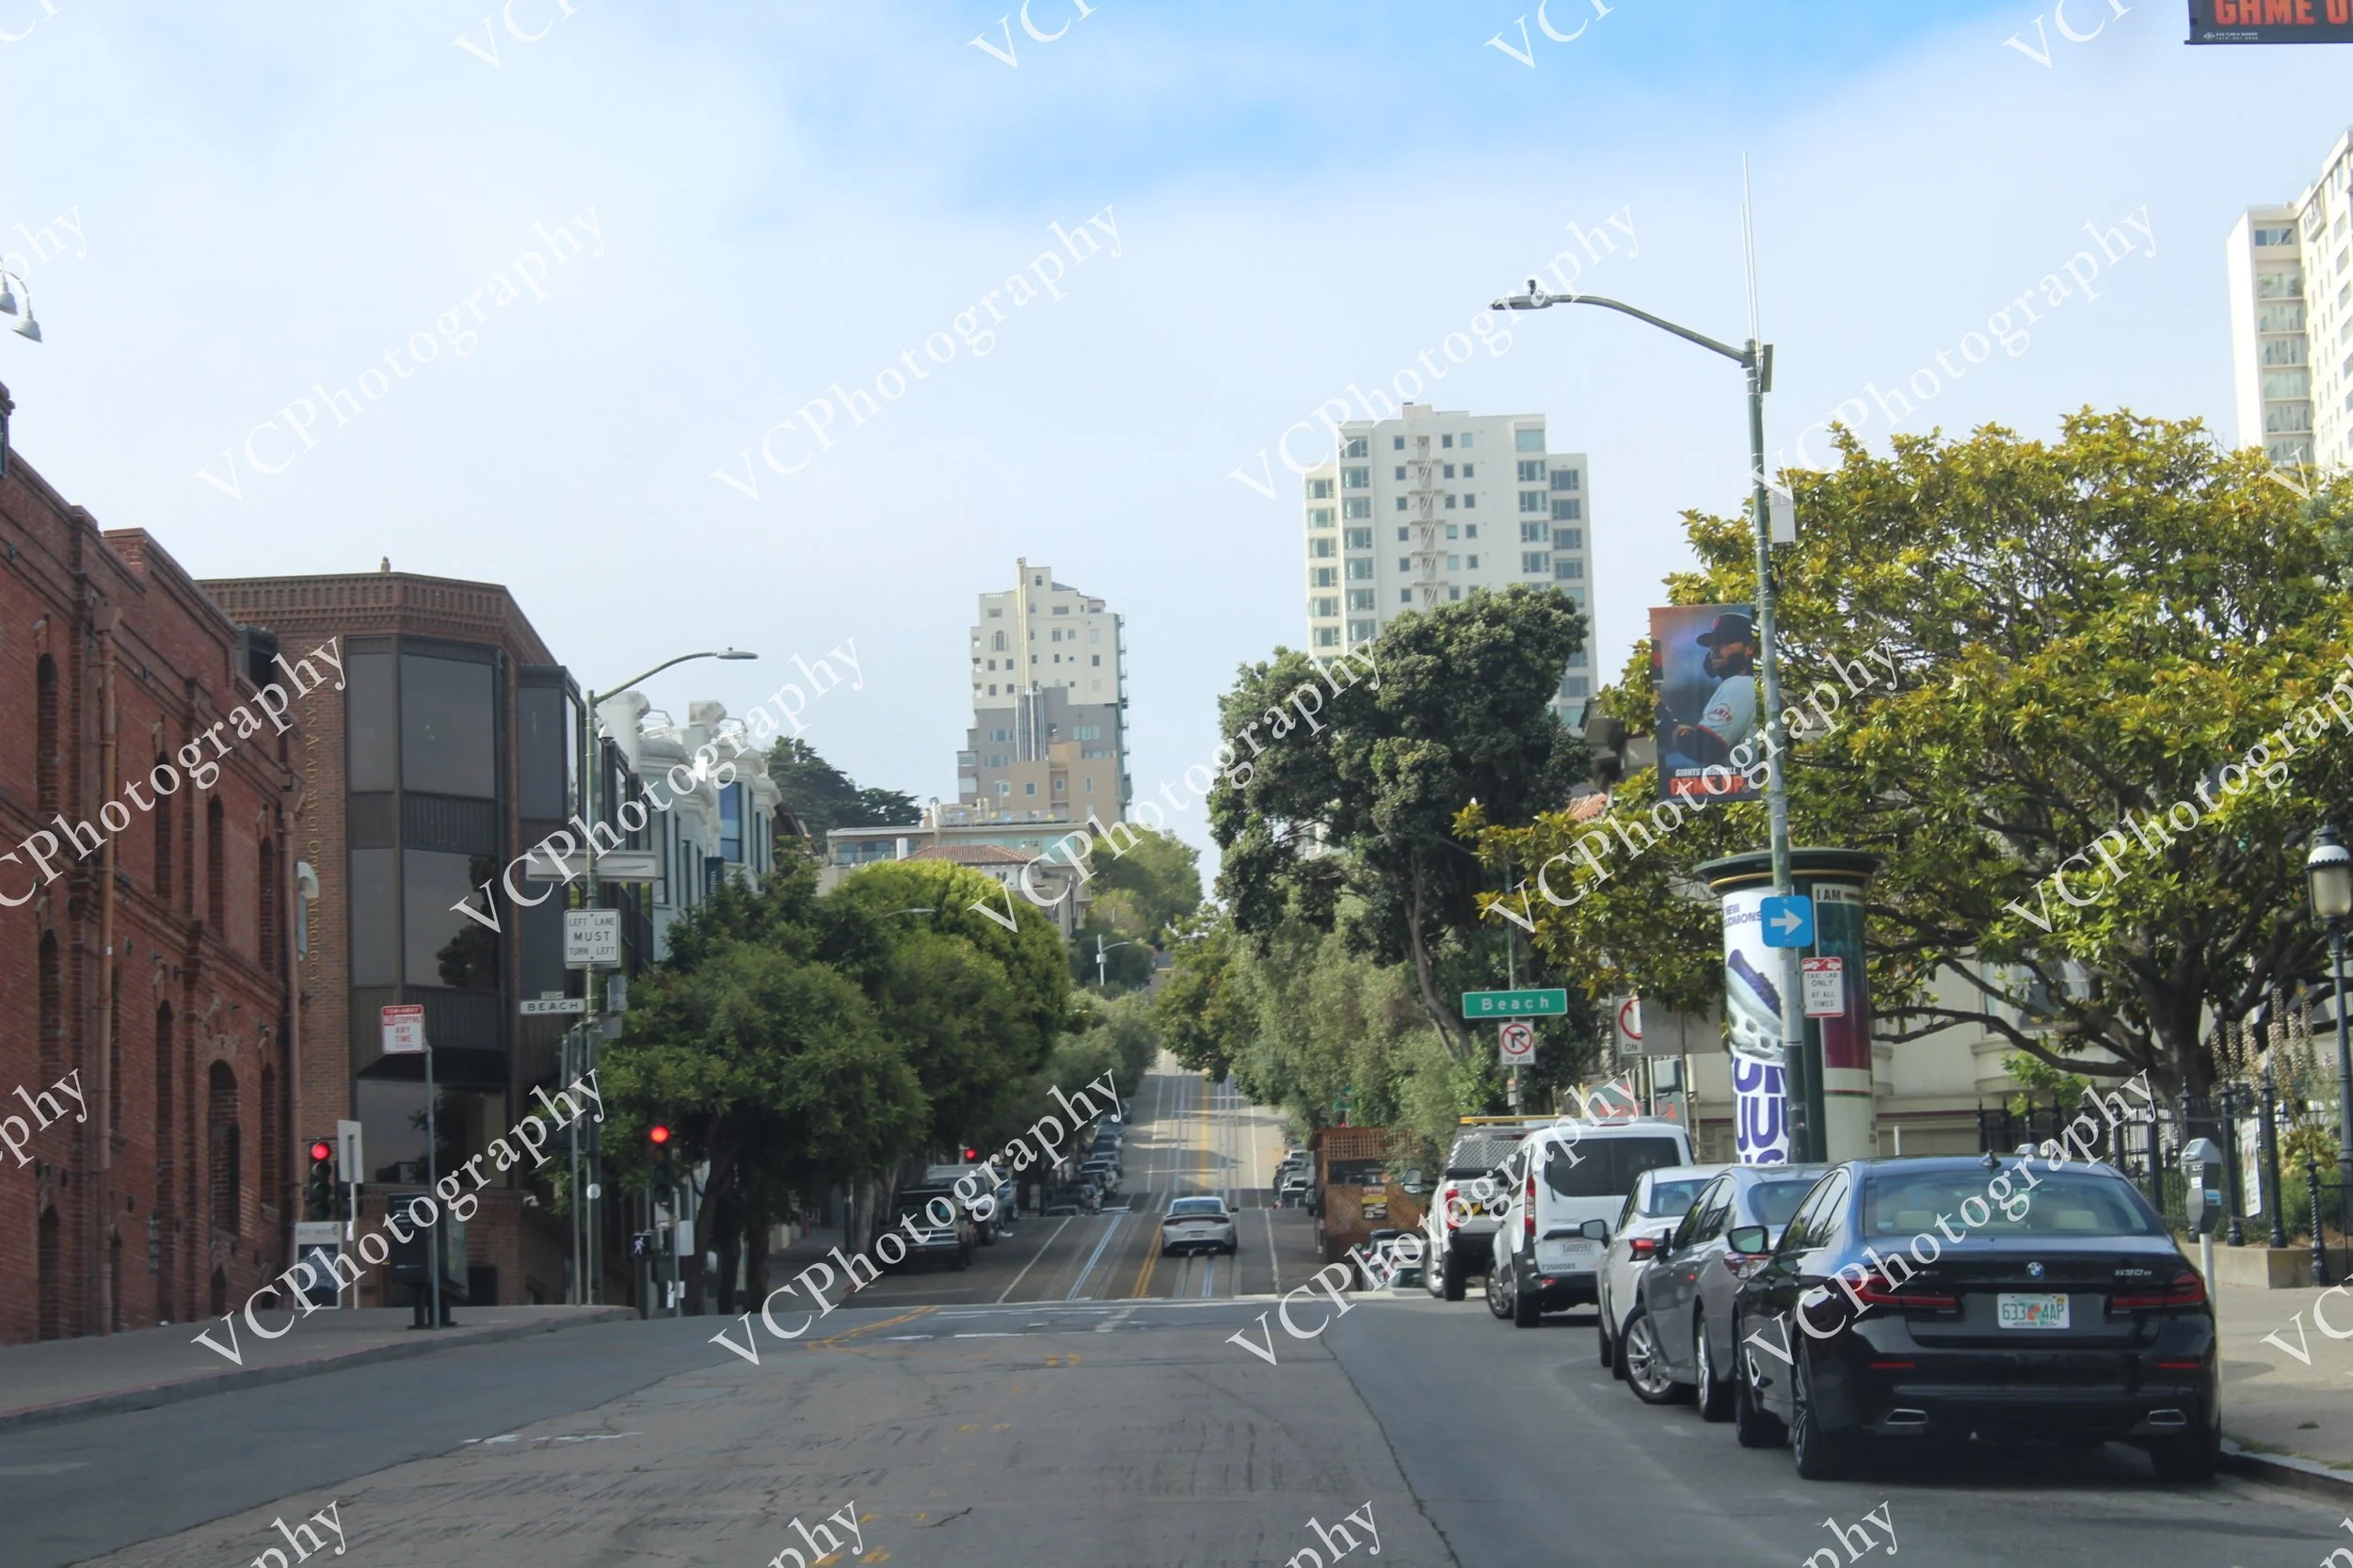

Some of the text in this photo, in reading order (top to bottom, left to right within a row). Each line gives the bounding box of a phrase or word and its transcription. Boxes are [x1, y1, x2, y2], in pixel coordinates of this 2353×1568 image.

[2215, 0, 2353, 25] GAME U
[306, 734, 320, 810] ACADEMY
[308, 816, 318, 832] OF
[1824, 888, 1842, 901] AM
[568, 918, 616, 926] LEFT LANE
[574, 931, 610, 941] MUST
[568, 947, 616, 955] TURN LEFT
[527, 1001, 579, 1012] BEACH
[1481, 996, 1549, 1011] Beach
